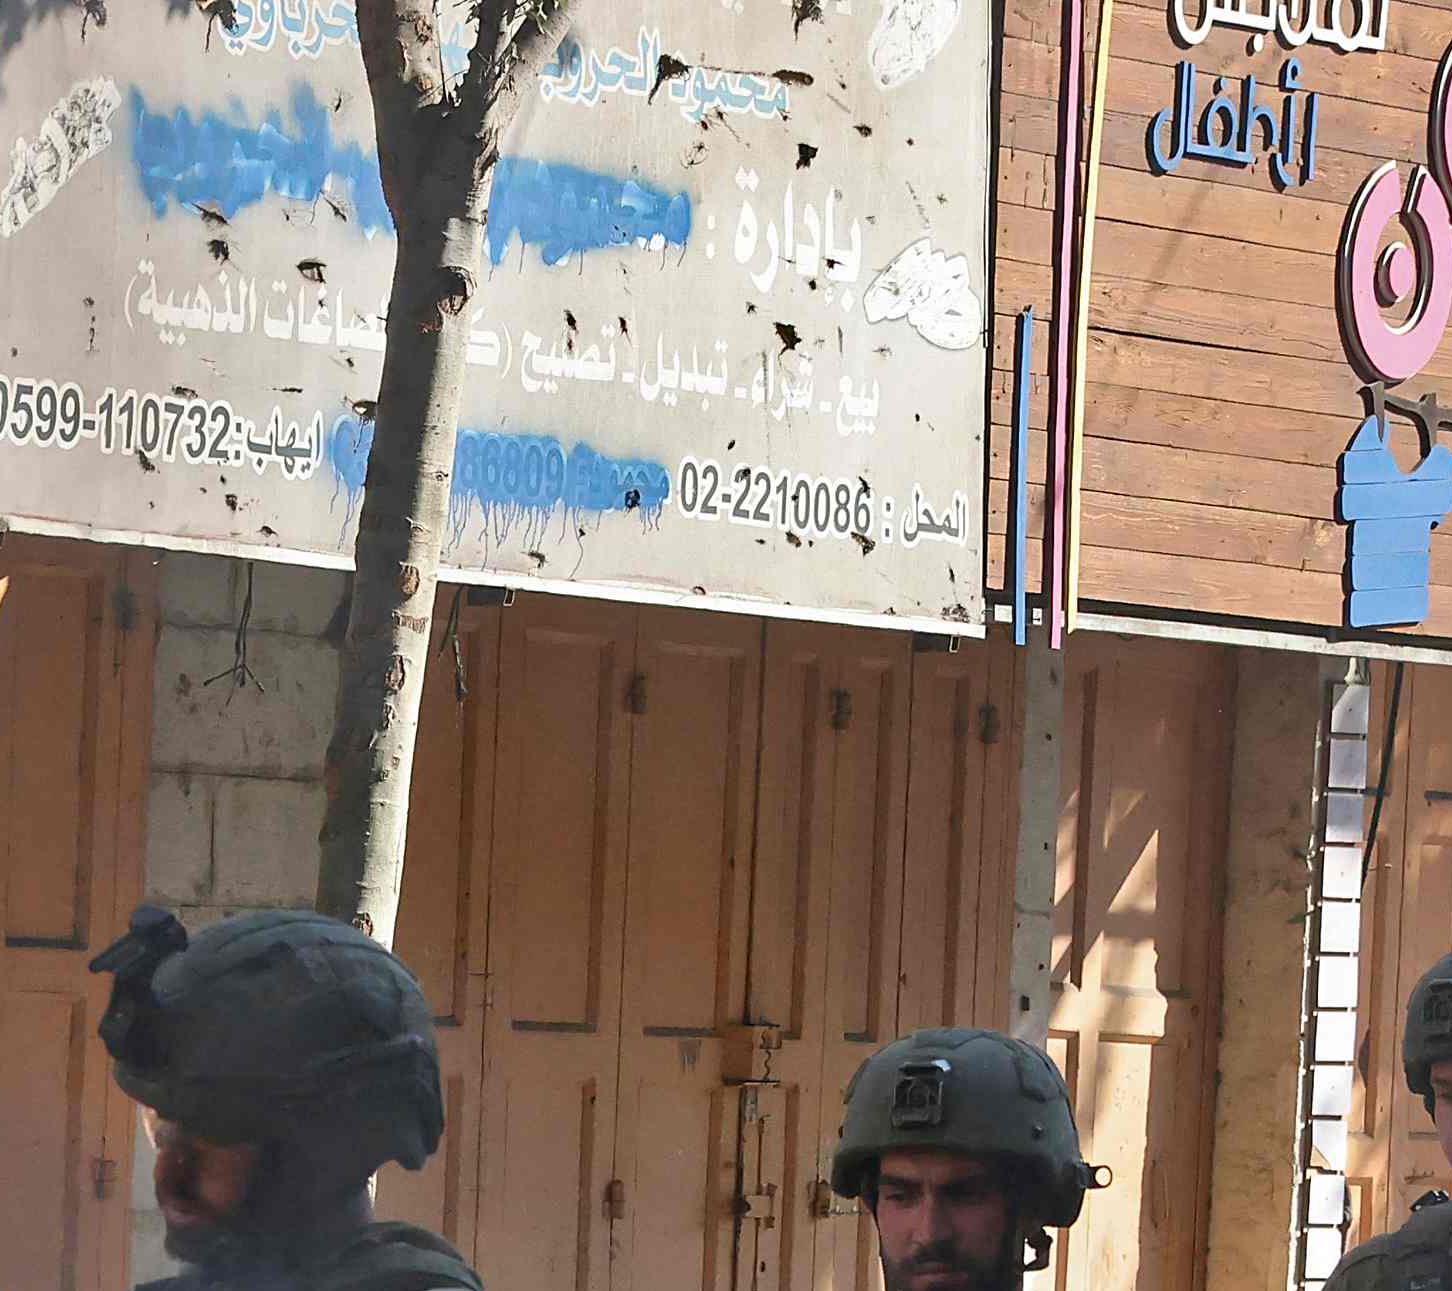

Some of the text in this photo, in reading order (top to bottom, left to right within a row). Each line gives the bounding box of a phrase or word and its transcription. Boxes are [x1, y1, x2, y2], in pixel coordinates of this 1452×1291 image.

[639, 342, 728, 410] تبديل
[836, 372, 881, 436] بيع
[679, 460, 872, 534] 02-2210086
